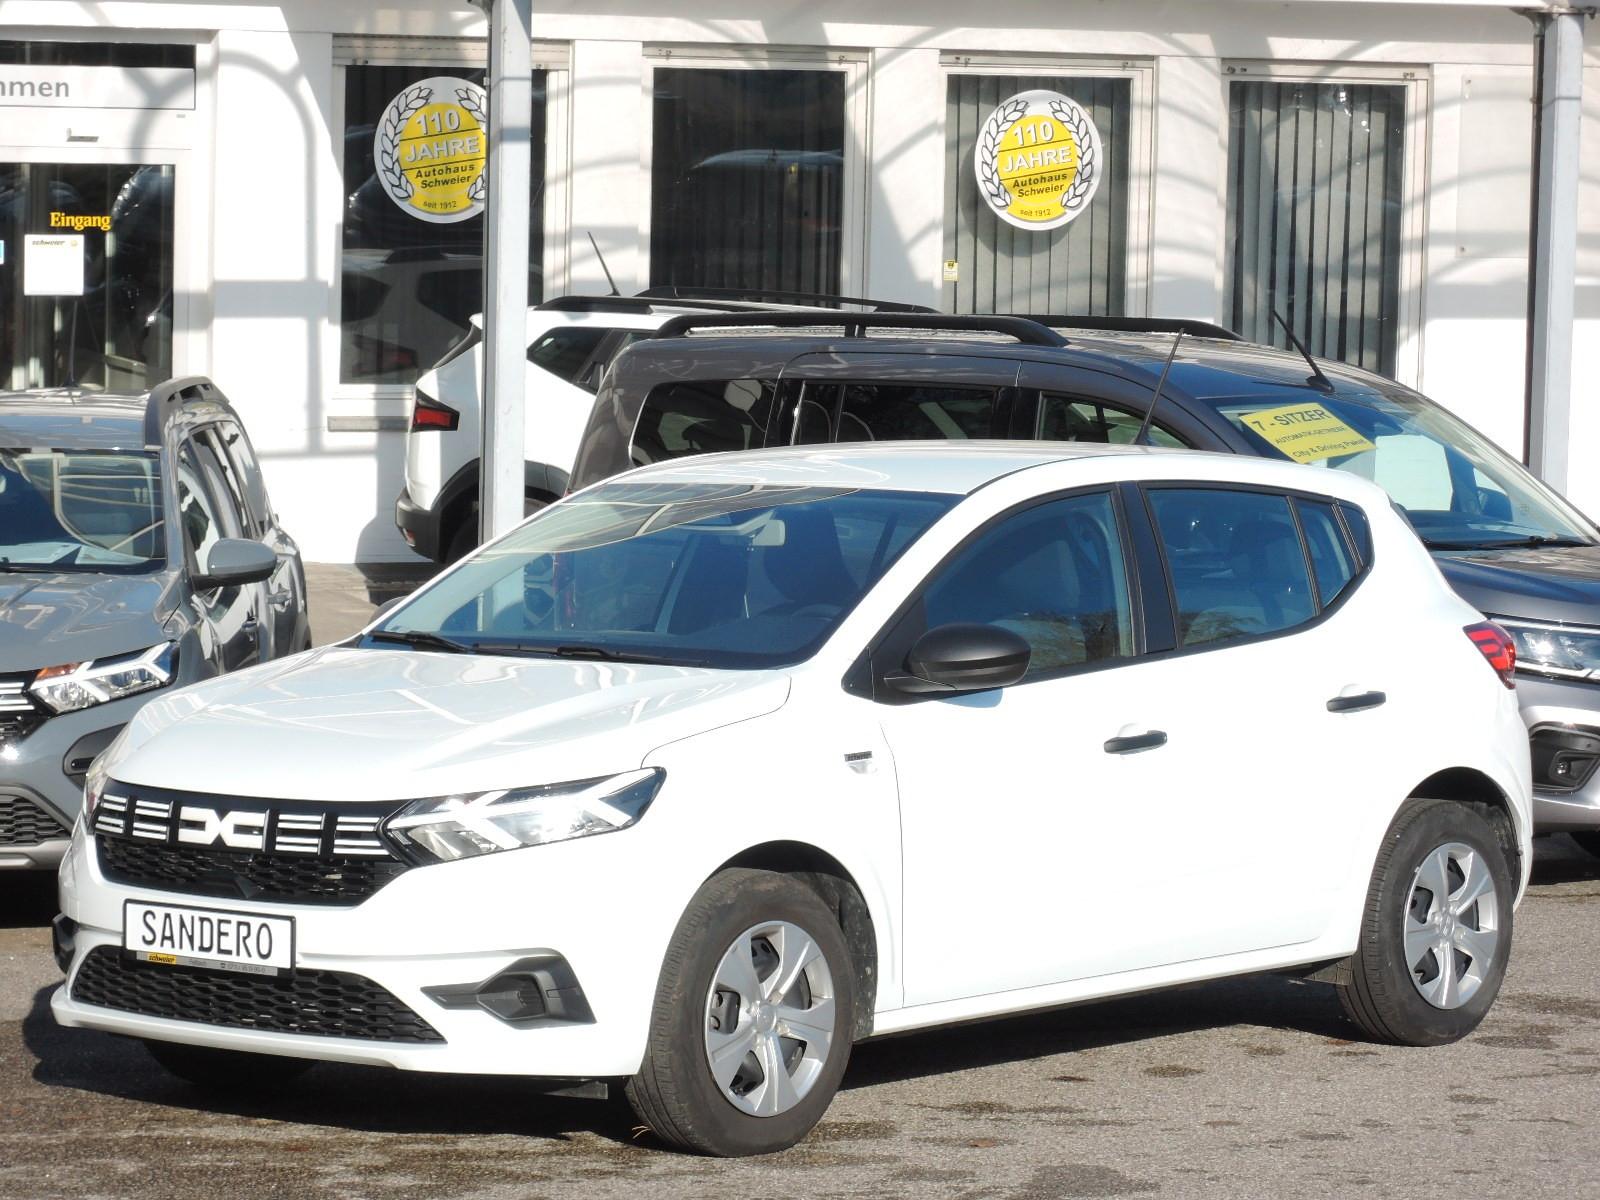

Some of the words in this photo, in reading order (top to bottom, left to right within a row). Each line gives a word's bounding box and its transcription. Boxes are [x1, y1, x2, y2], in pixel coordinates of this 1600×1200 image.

[416, 109, 460, 135] 110
[1014, 121, 1054, 146] 110
[406, 136, 480, 162] JAHRE
[1003, 146, 1073, 173] JAHRE
[415, 163, 475, 179] Autohaus
[421, 175, 472, 189] Schweier
[1012, 172, 1068, 188] Autohaus
[1018, 184, 1064, 198] Schweier
[423, 201, 437, 209] seit
[440, 201, 457, 209] 1912
[1020, 209, 1032, 217] seit
[1035, 209, 1051, 217] 1912
[50, 212, 112, 231] Eingang
[1251, 420, 1265, 432] 7
[1274, 409, 1332, 427] SITZER
[1292, 448, 1311, 457] City
[142, 910, 273, 960] SANDERO
[148, 953, 175, 963] schweier
